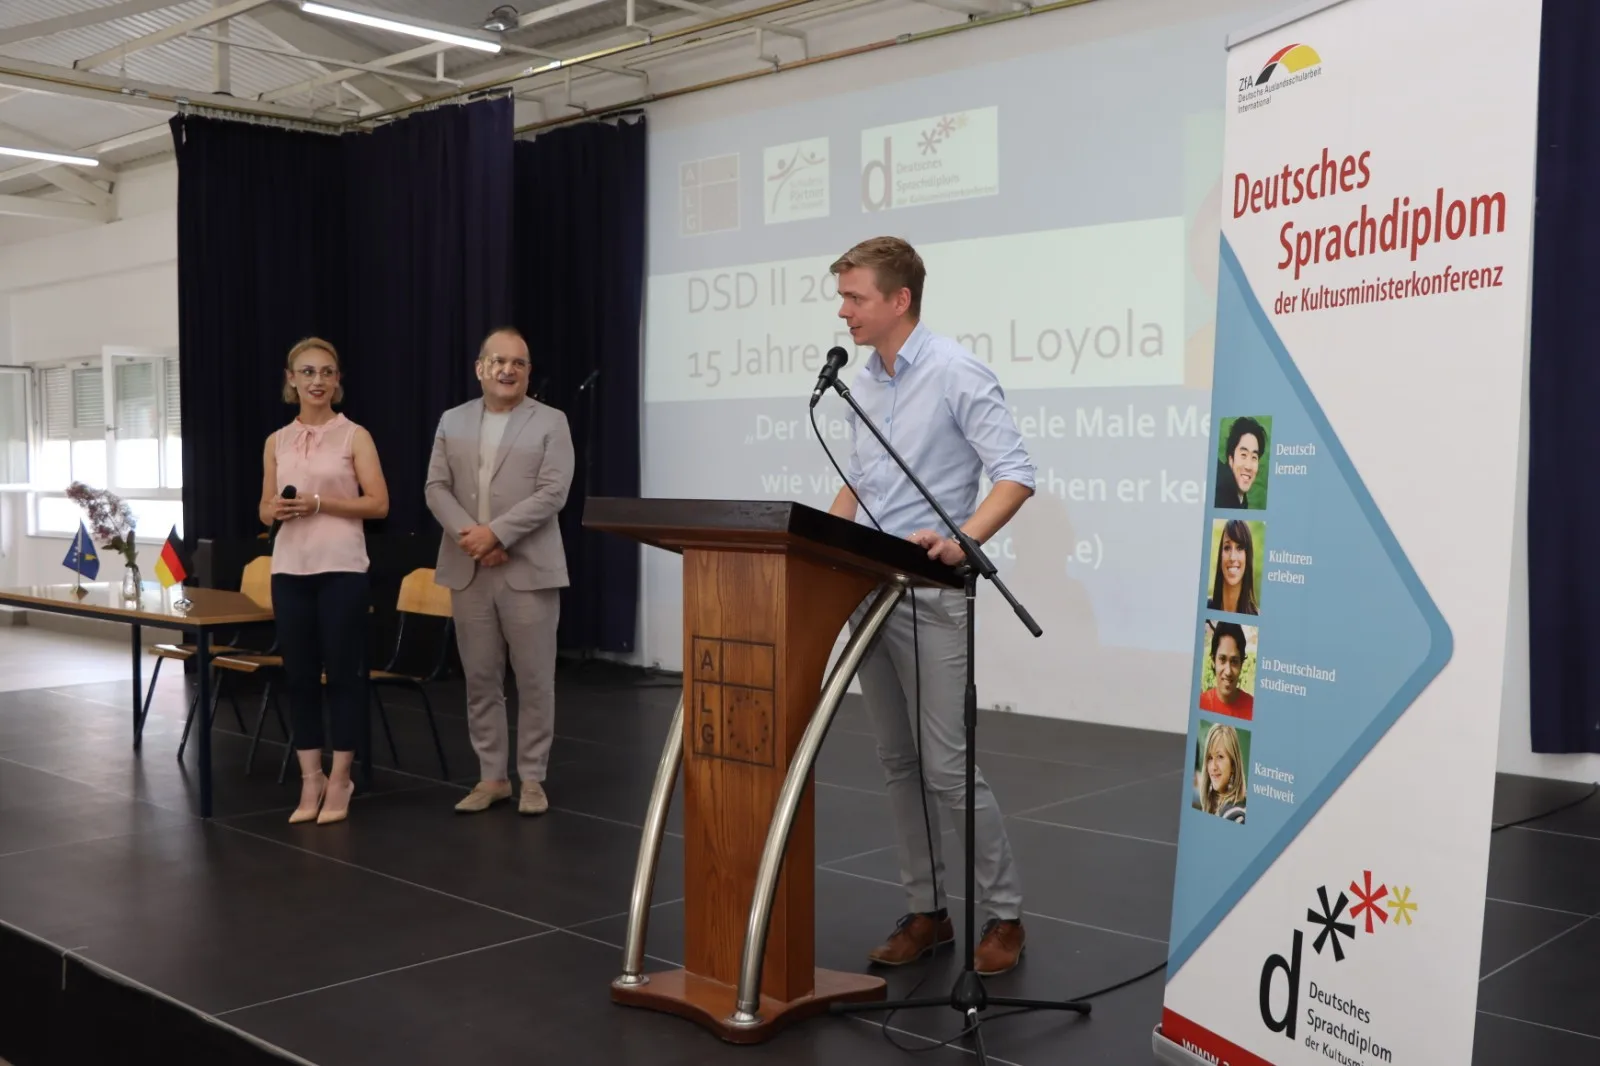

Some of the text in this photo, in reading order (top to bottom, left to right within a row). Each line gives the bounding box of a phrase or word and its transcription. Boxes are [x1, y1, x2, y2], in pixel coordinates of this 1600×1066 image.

[1238, 75, 1253, 92] ZfA
[1238, 88, 1264, 103] Deutsche
[1238, 95, 1272, 114] International
[1233, 147, 1371, 219] Deutsches
[1277, 187, 1506, 280] Sprachdiplom
[688, 272, 758, 313] DSD
[1274, 264, 1504, 315] der Kultusministerkonferenz
[688, 350, 722, 388] 15
[730, 332, 820, 377] Jahre
[1009, 309, 1165, 375] Loyola
[1075, 404, 1155, 438] Male
[1276, 442, 1316, 457] Deutsch
[1275, 461, 1308, 476] lernen
[761, 466, 803, 495] wie
[1117, 477, 1151, 502] er
[1269, 550, 1313, 566] Kulturen
[1267, 569, 1305, 585] erleben
[1261, 657, 1336, 682] in Deutschland
[1260, 676, 1307, 697] studieren
[1254, 762, 1295, 784] Karriere
[1253, 781, 1295, 804] weltweit
[1259, 929, 1303, 1040] d
[1308, 981, 1371, 1024] Deutsches
[1305, 1035, 1320, 1051] der
[1307, 1009, 1392, 1063] Sprachdiplom
